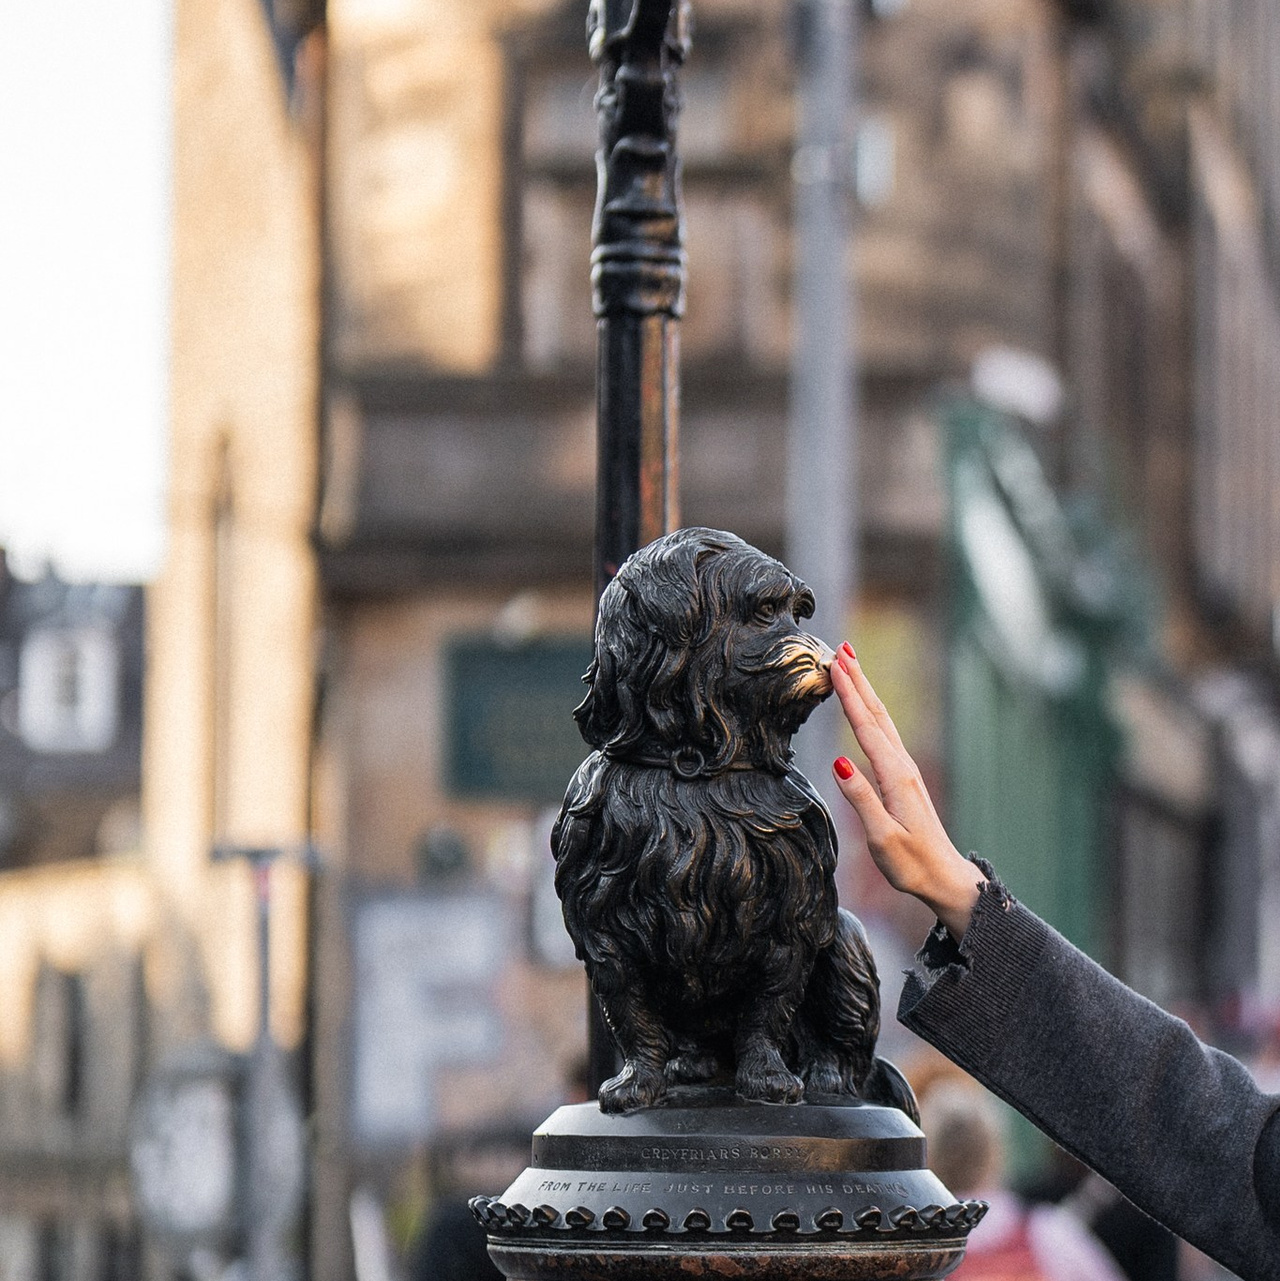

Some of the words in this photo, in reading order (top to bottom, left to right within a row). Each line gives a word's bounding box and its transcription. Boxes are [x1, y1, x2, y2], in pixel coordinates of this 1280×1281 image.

[641, 1147, 741, 1161] GREYFRIARS
[750, 1147, 805, 1160] BOBBY
[538, 1180, 572, 1192] FROM
[577, 1181, 606, 1193] THE
[612, 1182, 652, 1194] LIFE
[664, 1182, 714, 1194] JUST
[723, 1184, 797, 1195] BEFORE
[806, 1184, 834, 1195] HIS
